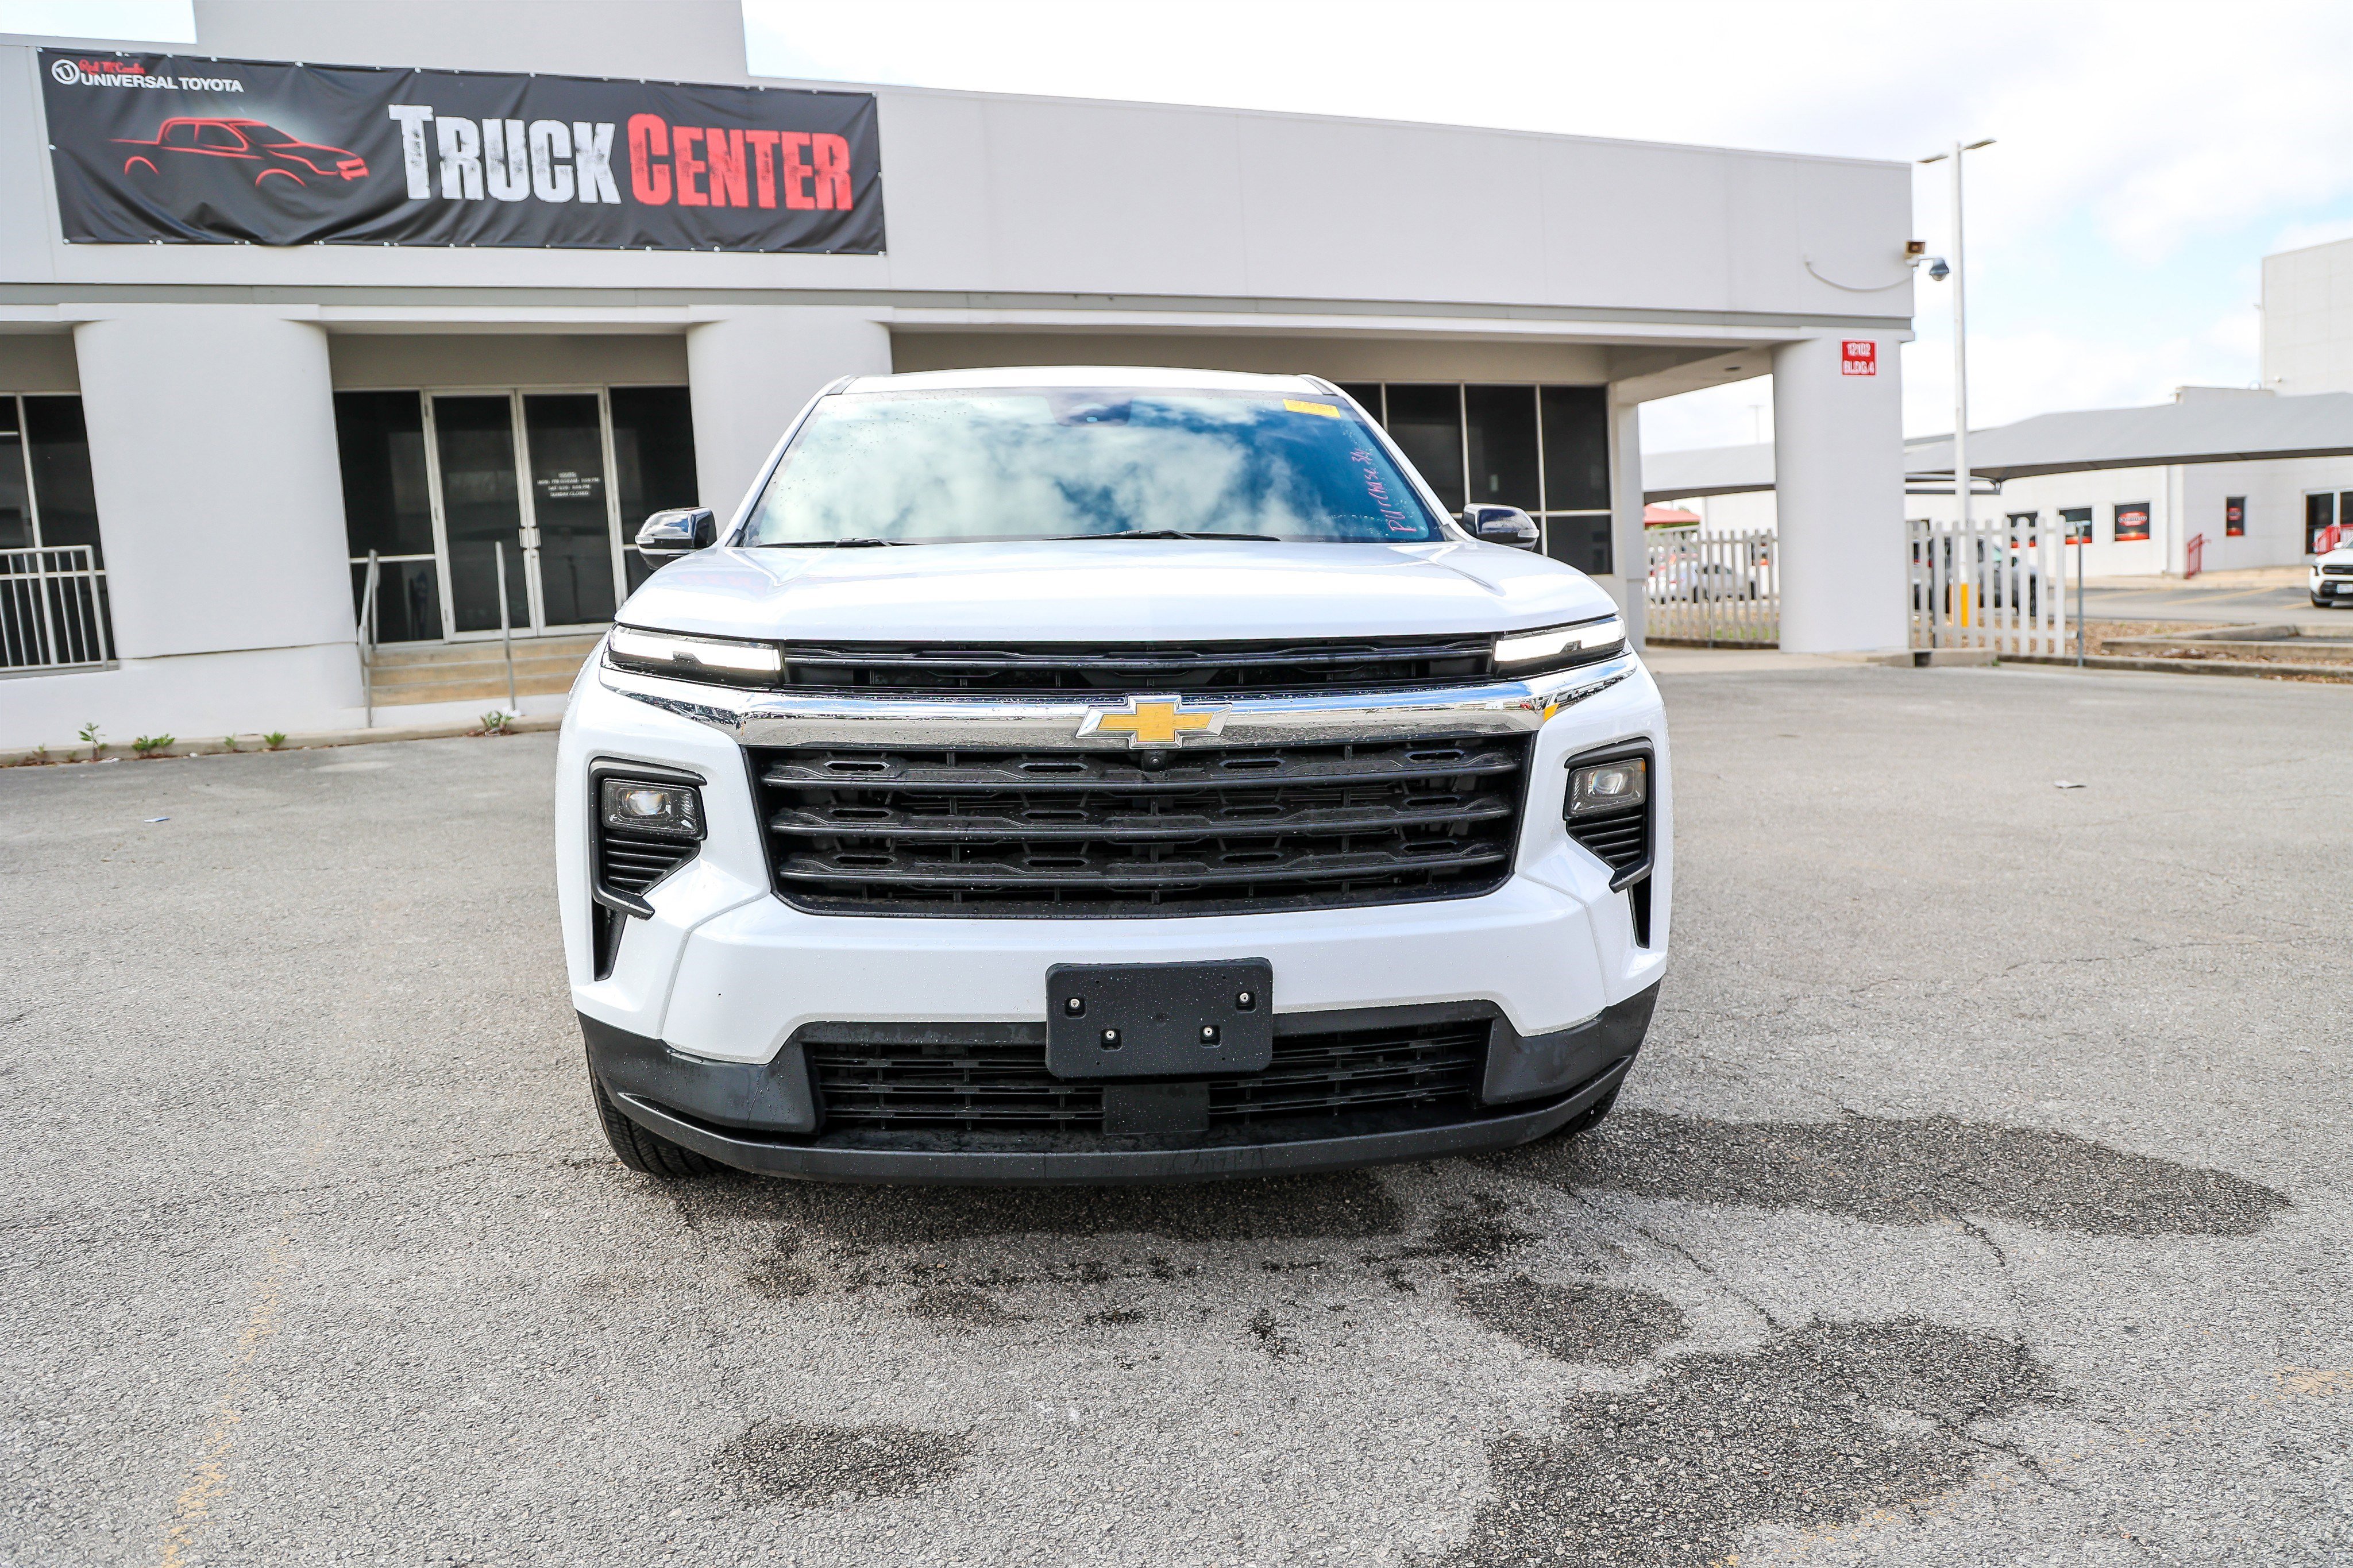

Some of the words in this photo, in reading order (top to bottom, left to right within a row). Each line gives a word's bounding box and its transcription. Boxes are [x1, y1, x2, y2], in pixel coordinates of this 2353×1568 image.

[80, 72, 178, 90] UNIVERSAL
[178, 77, 245, 93] TOYOTA
[388, 104, 622, 205] TRUCK
[627, 113, 854, 211] CENTER
